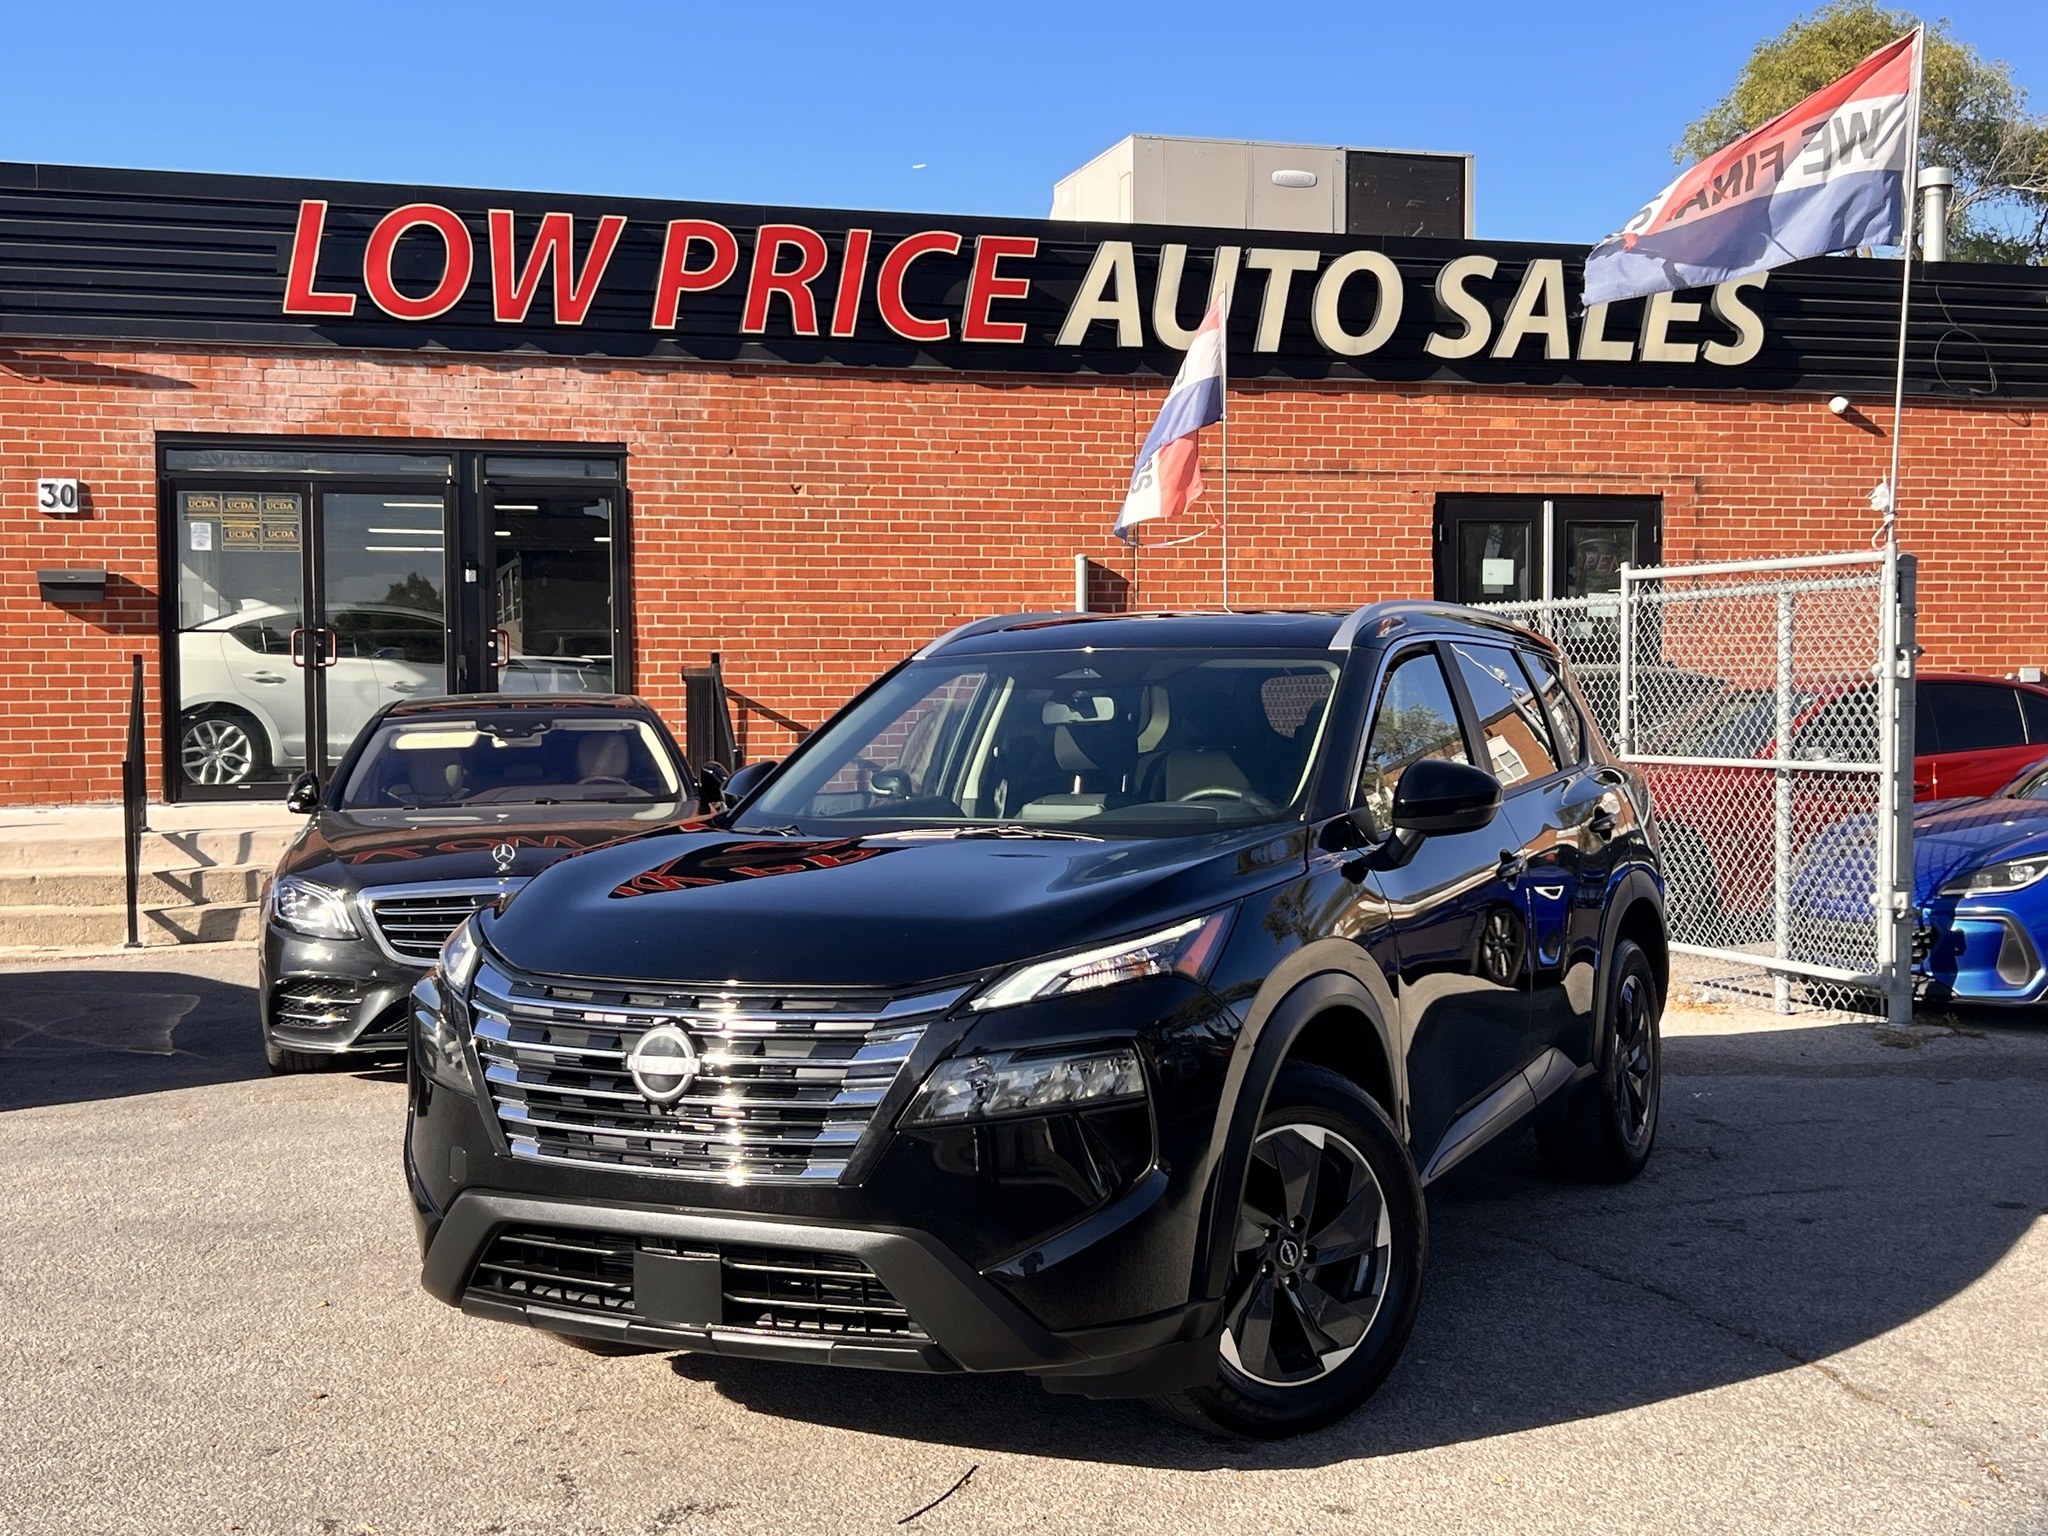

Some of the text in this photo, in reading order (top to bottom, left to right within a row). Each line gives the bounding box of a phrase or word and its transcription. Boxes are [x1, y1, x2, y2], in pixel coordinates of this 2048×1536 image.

[283, 199, 1769, 366] LOW PRICE AUTO SALES
[41, 483, 75, 508] 30
[188, 500, 216, 508] UCDA
[227, 501, 255, 510] UCDA
[266, 502, 294, 510] UCDA
[228, 531, 255, 539] UCDA
[627, 1056, 698, 1074] NISSAN
